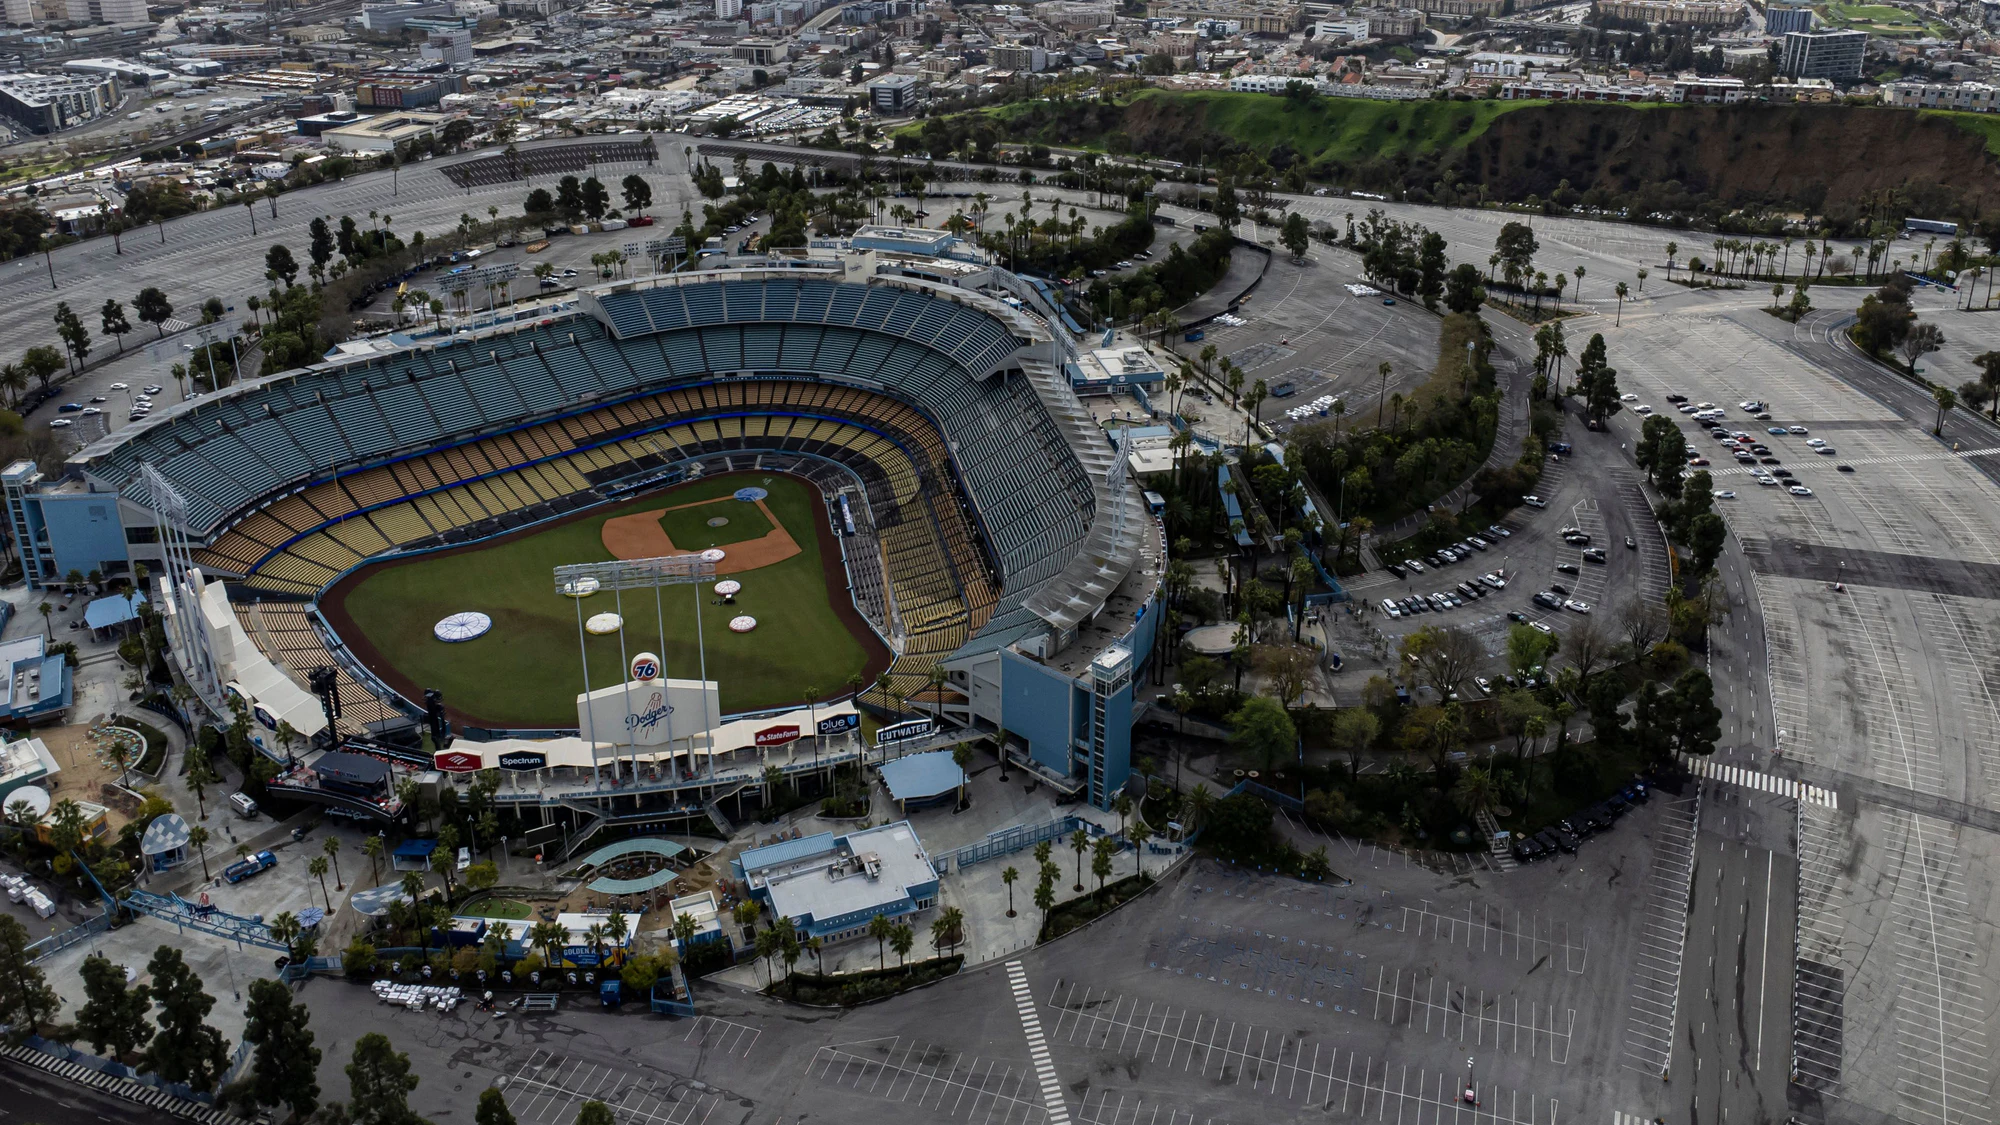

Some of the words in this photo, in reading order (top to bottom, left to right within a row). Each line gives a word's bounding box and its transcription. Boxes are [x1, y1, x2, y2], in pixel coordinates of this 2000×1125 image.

[635, 662, 656, 678] 76
[625, 705, 675, 730] Dodgers
[820, 719, 845, 730] blue
[880, 723, 928, 740] CUTWATER
[502, 757, 540, 766] Spectrum
[563, 947, 590, 956] GOLDEN
